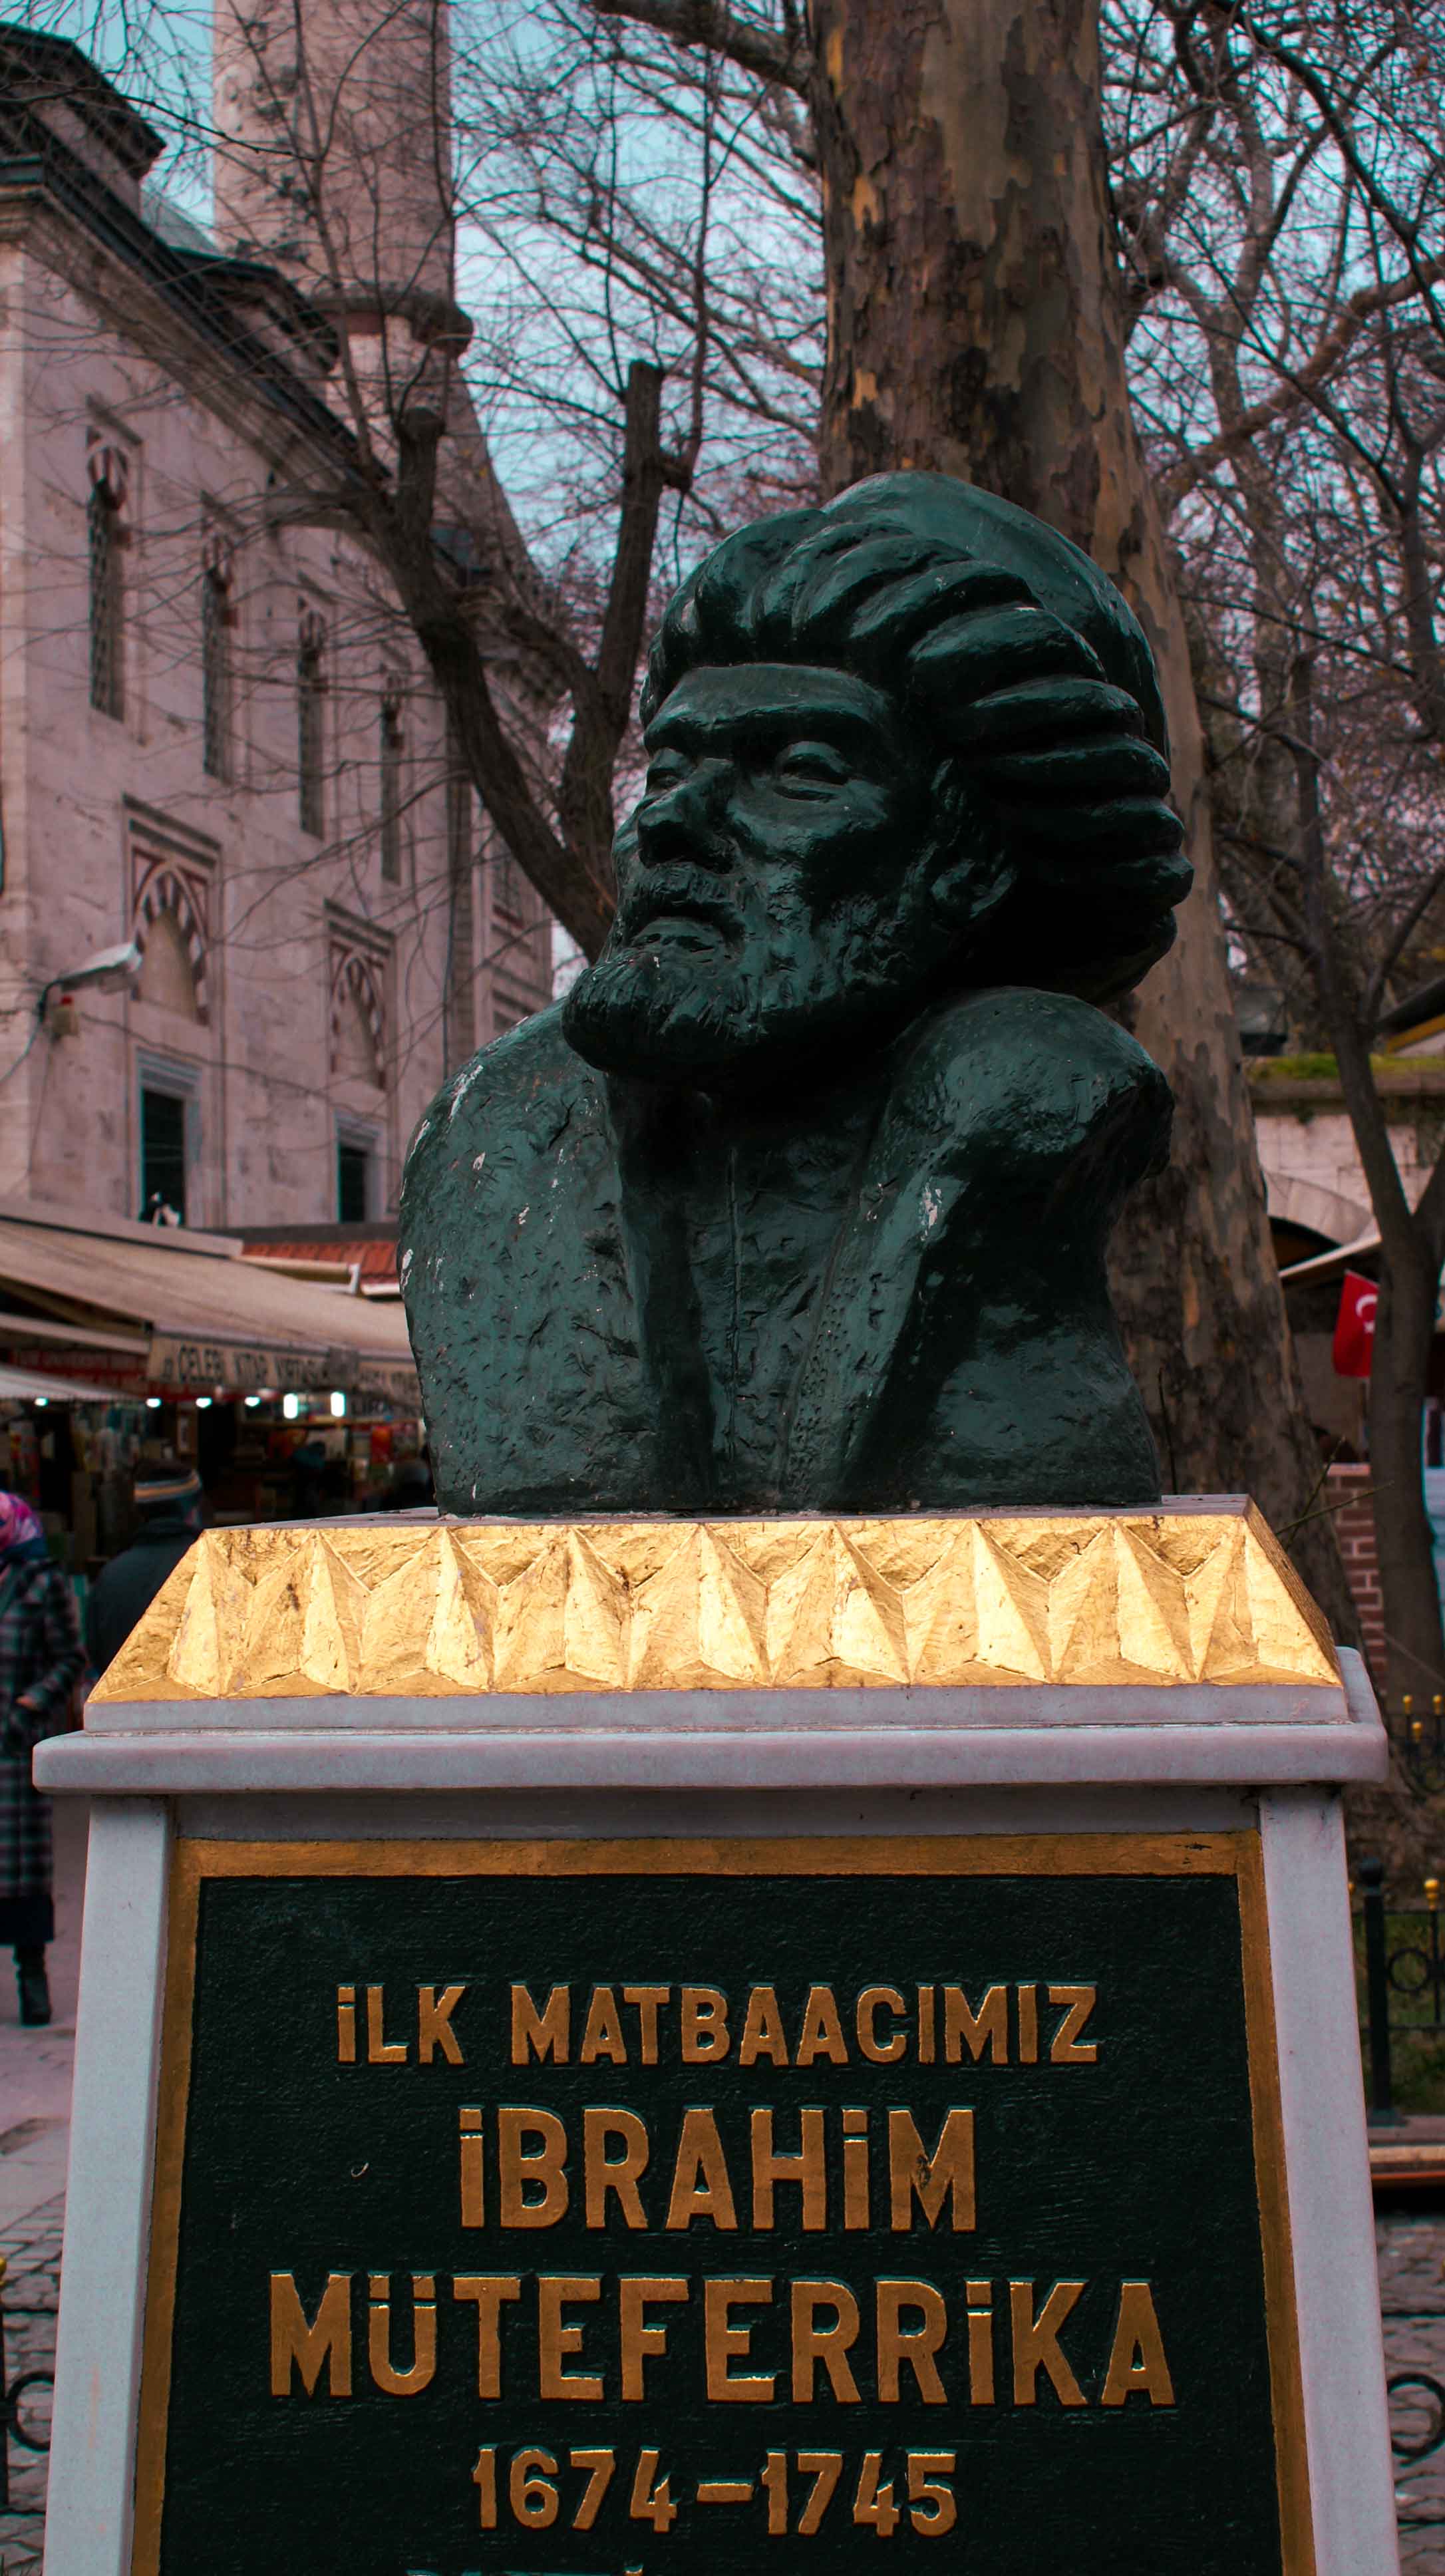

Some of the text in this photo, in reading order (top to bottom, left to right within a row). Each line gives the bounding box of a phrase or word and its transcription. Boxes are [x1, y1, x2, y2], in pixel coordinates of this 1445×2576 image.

[337, 1982, 1099, 2066] İLK MATBAACIMIZ
[458, 2104, 977, 2231] İBRAHİM
[269, 2271, 1176, 2406] MÜTEFERRİKA
